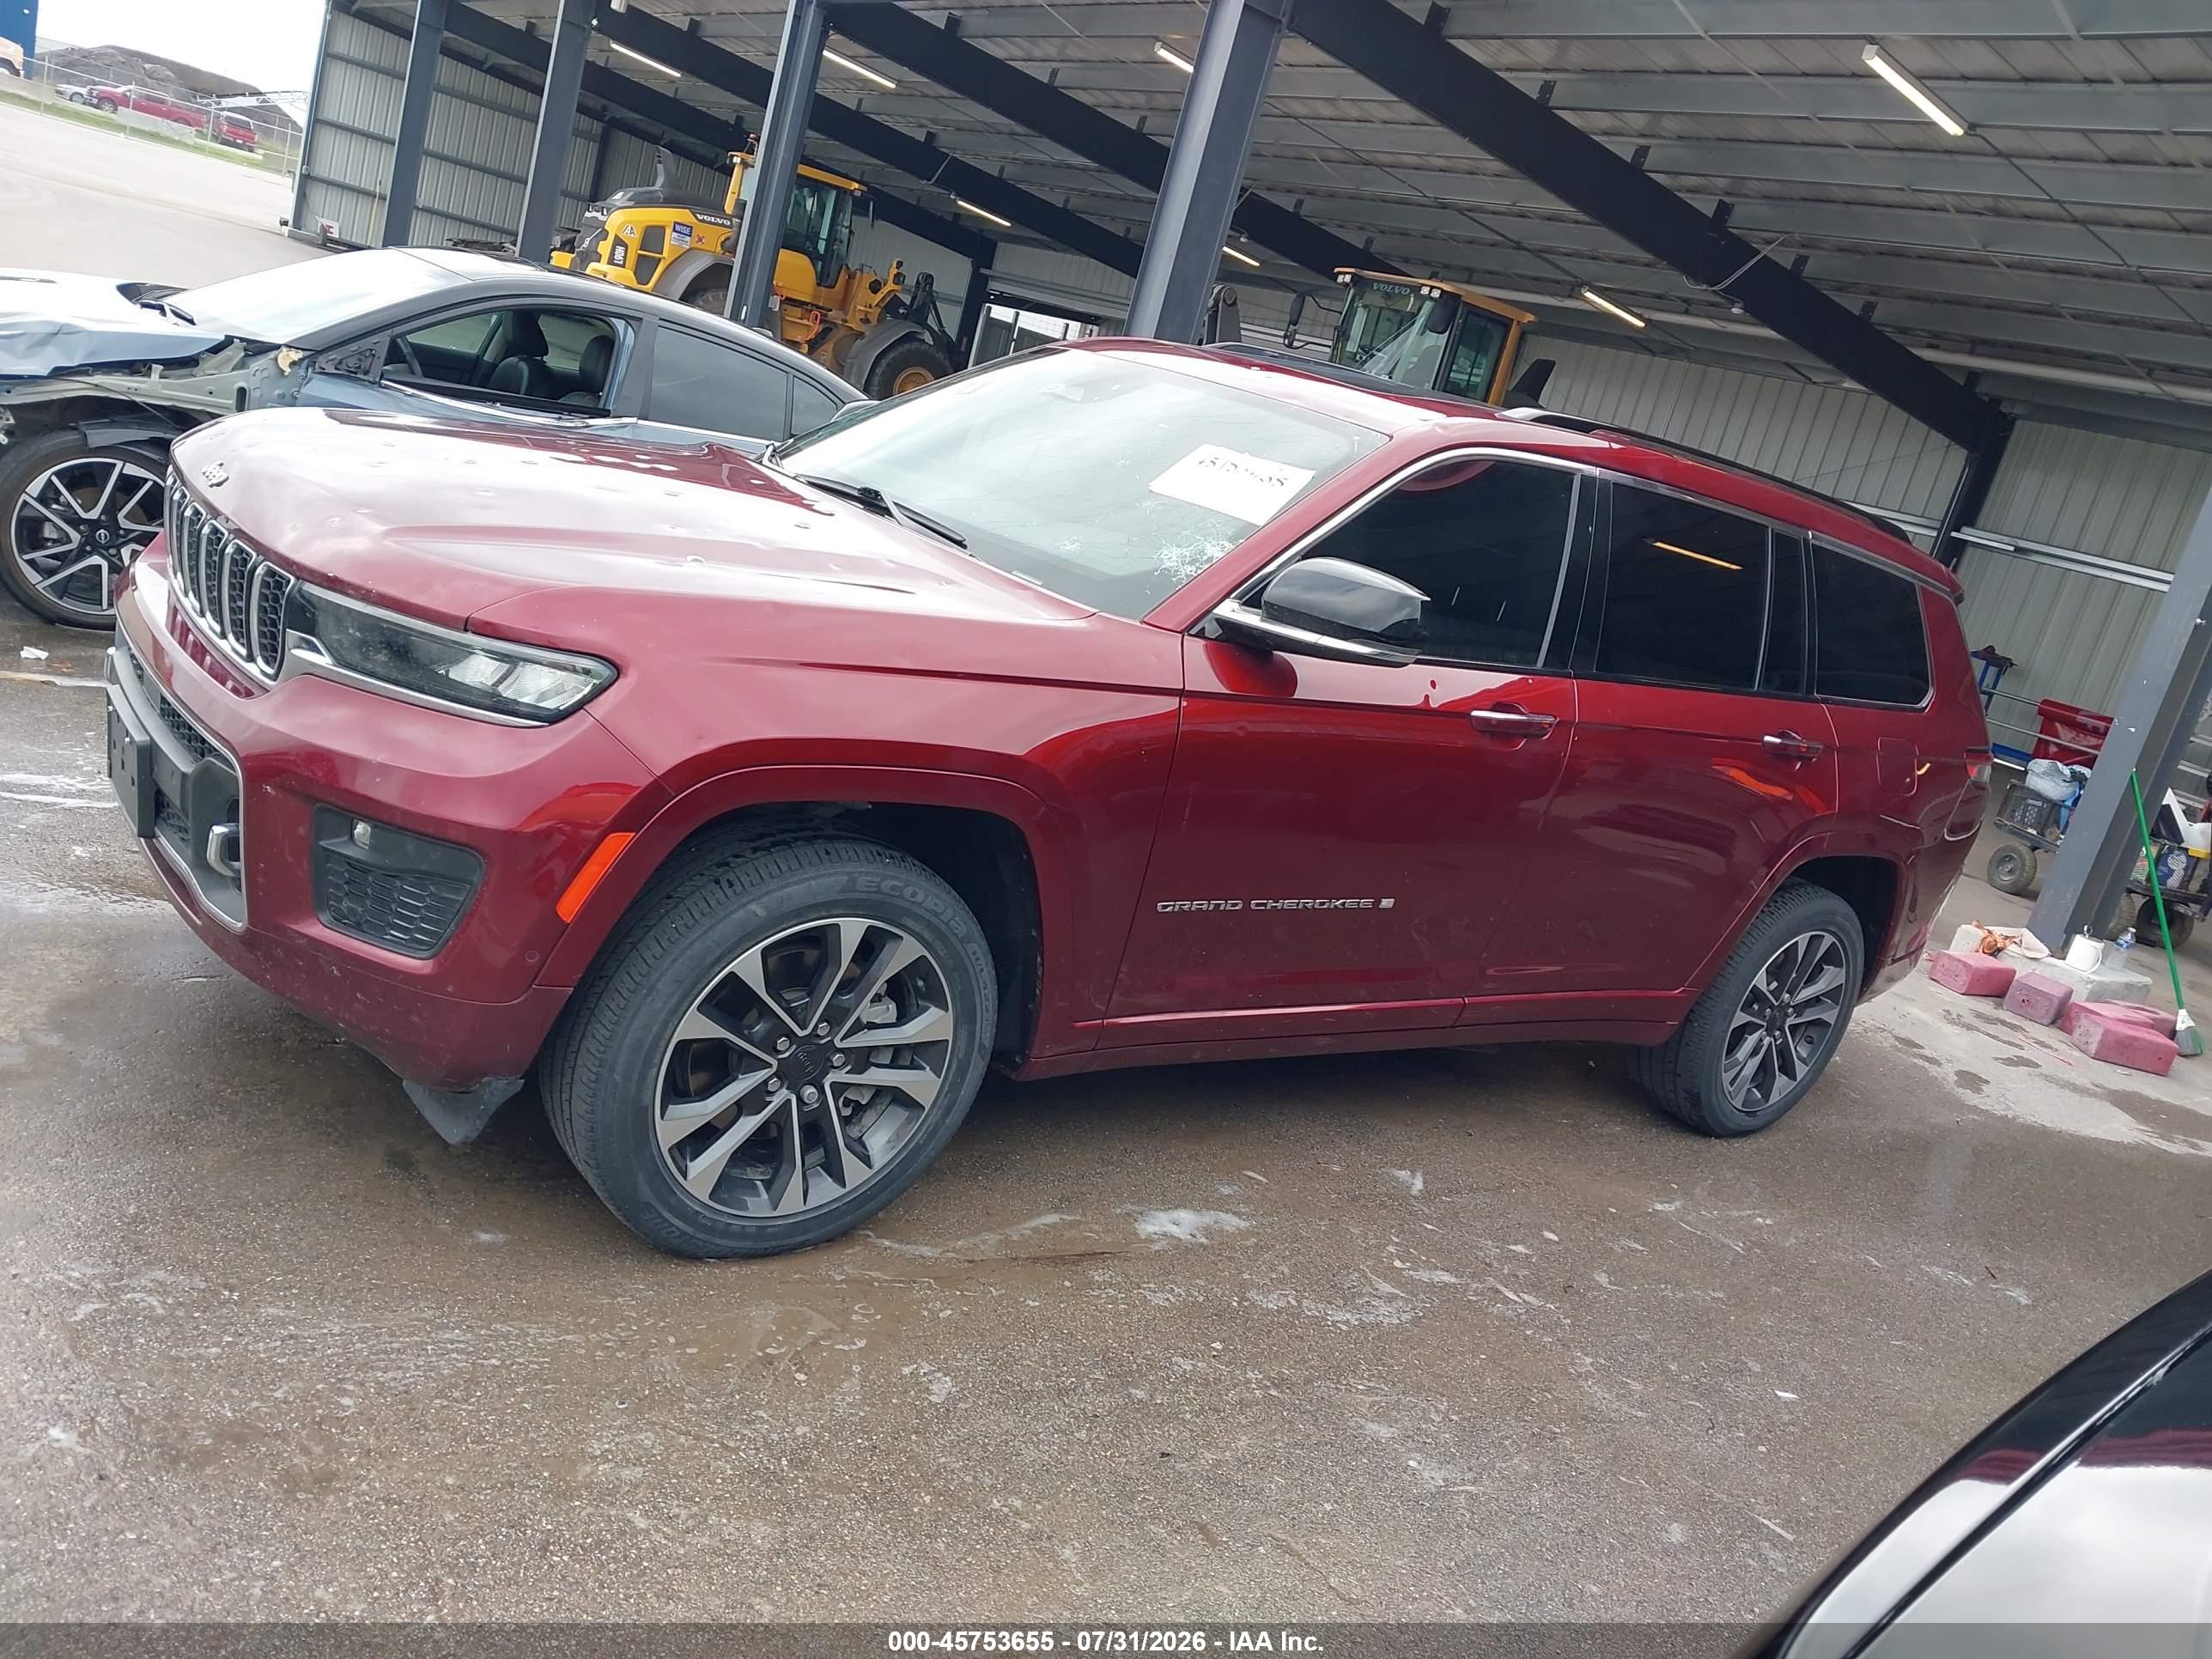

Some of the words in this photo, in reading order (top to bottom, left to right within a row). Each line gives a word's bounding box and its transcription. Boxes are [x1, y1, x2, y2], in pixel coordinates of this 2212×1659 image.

[696, 214, 731, 225] VOLVO
[674, 223, 691, 235] WISE
[613, 246, 626, 264] L90H
[1373, 283, 1410, 295] VOLVO
[1157, 900, 1243, 912] GRAND
[1250, 899, 1375, 911] CHEROKEE
